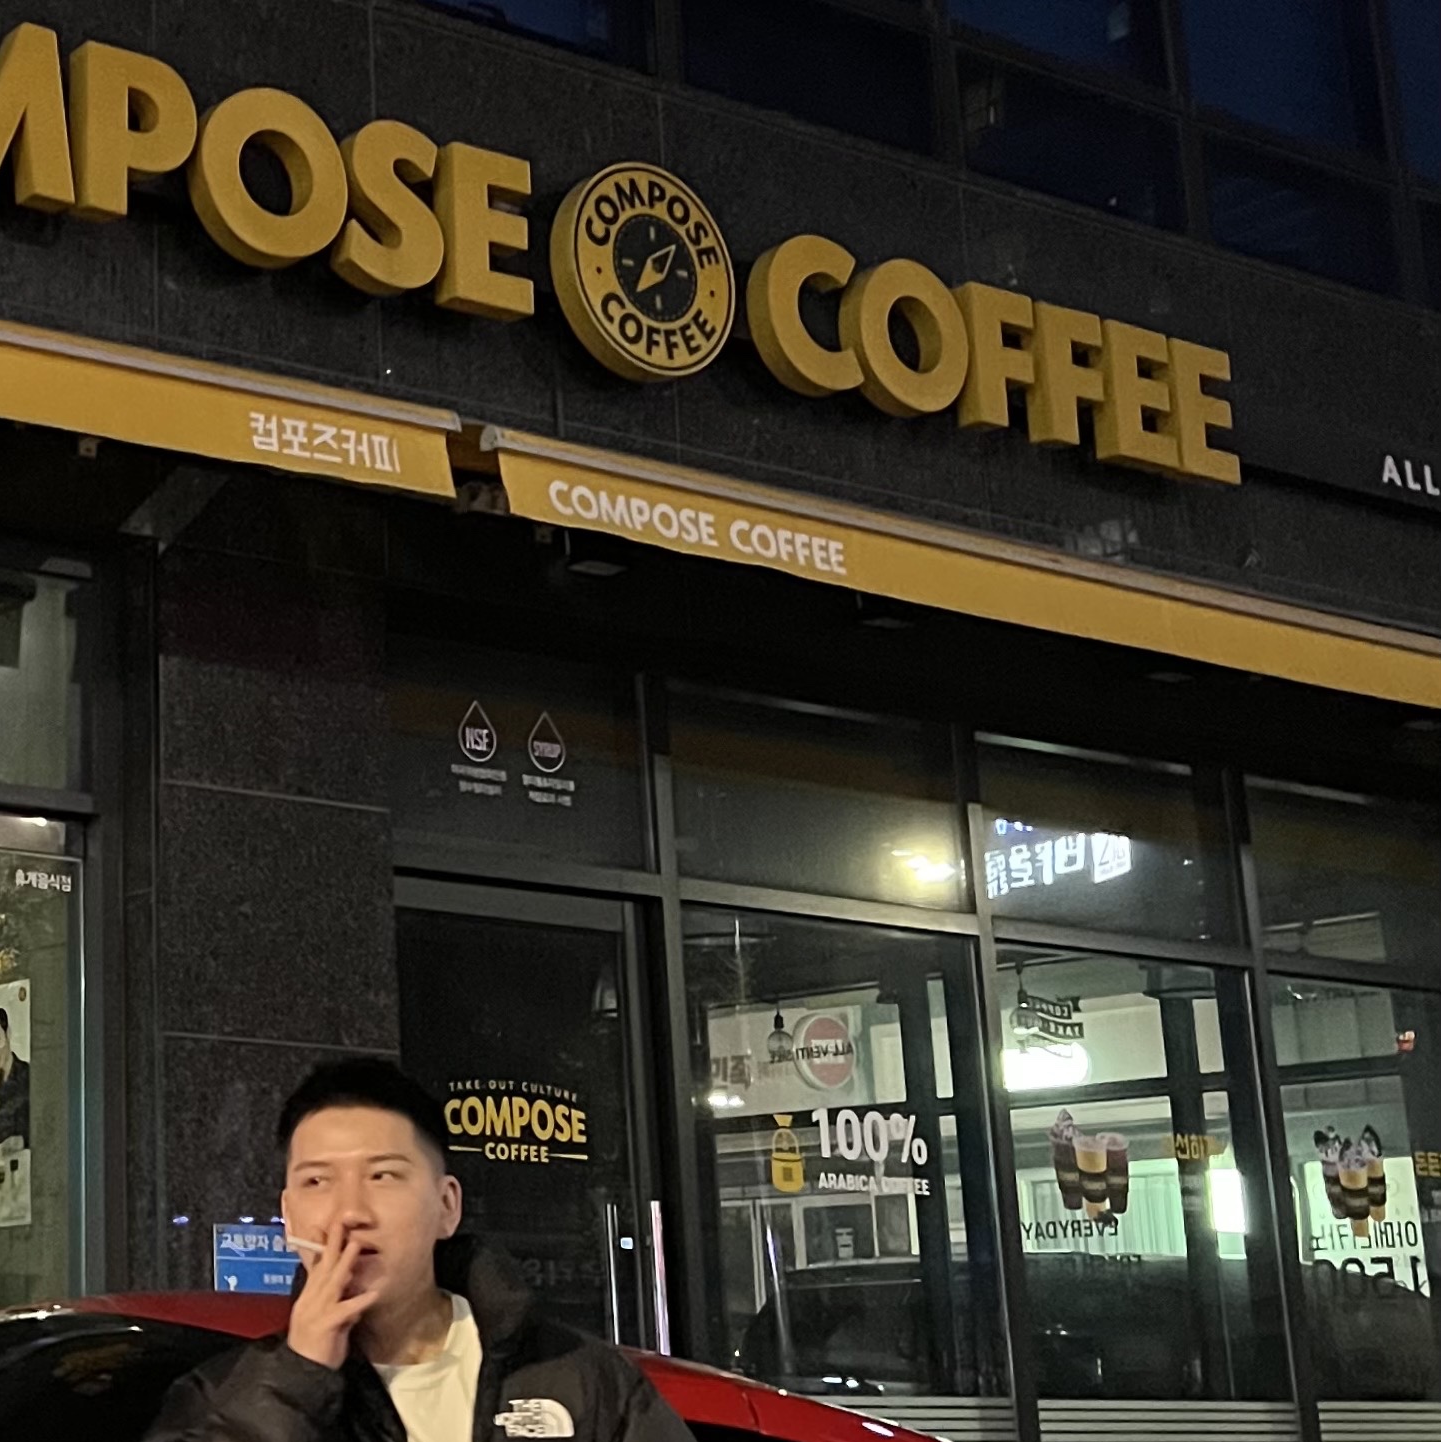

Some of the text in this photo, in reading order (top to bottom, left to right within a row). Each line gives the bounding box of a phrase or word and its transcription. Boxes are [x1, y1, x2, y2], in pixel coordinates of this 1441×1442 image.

[585, 178, 720, 270] COMPOSE
[601, 293, 716, 361] COFFEE
[747, 234, 1242, 486] COFFEE
[249, 411, 401, 474] 컴포즈커피
[1382, 455, 1440, 496] ALL
[549, 480, 848, 576] COMPOSE COFFEE
[444, 1096, 587, 1143] COMPOSE
[812, 1108, 928, 1165] 100%
[484, 1142, 549, 1163] COFFEE
[818, 1172, 878, 1191] ARABICA
